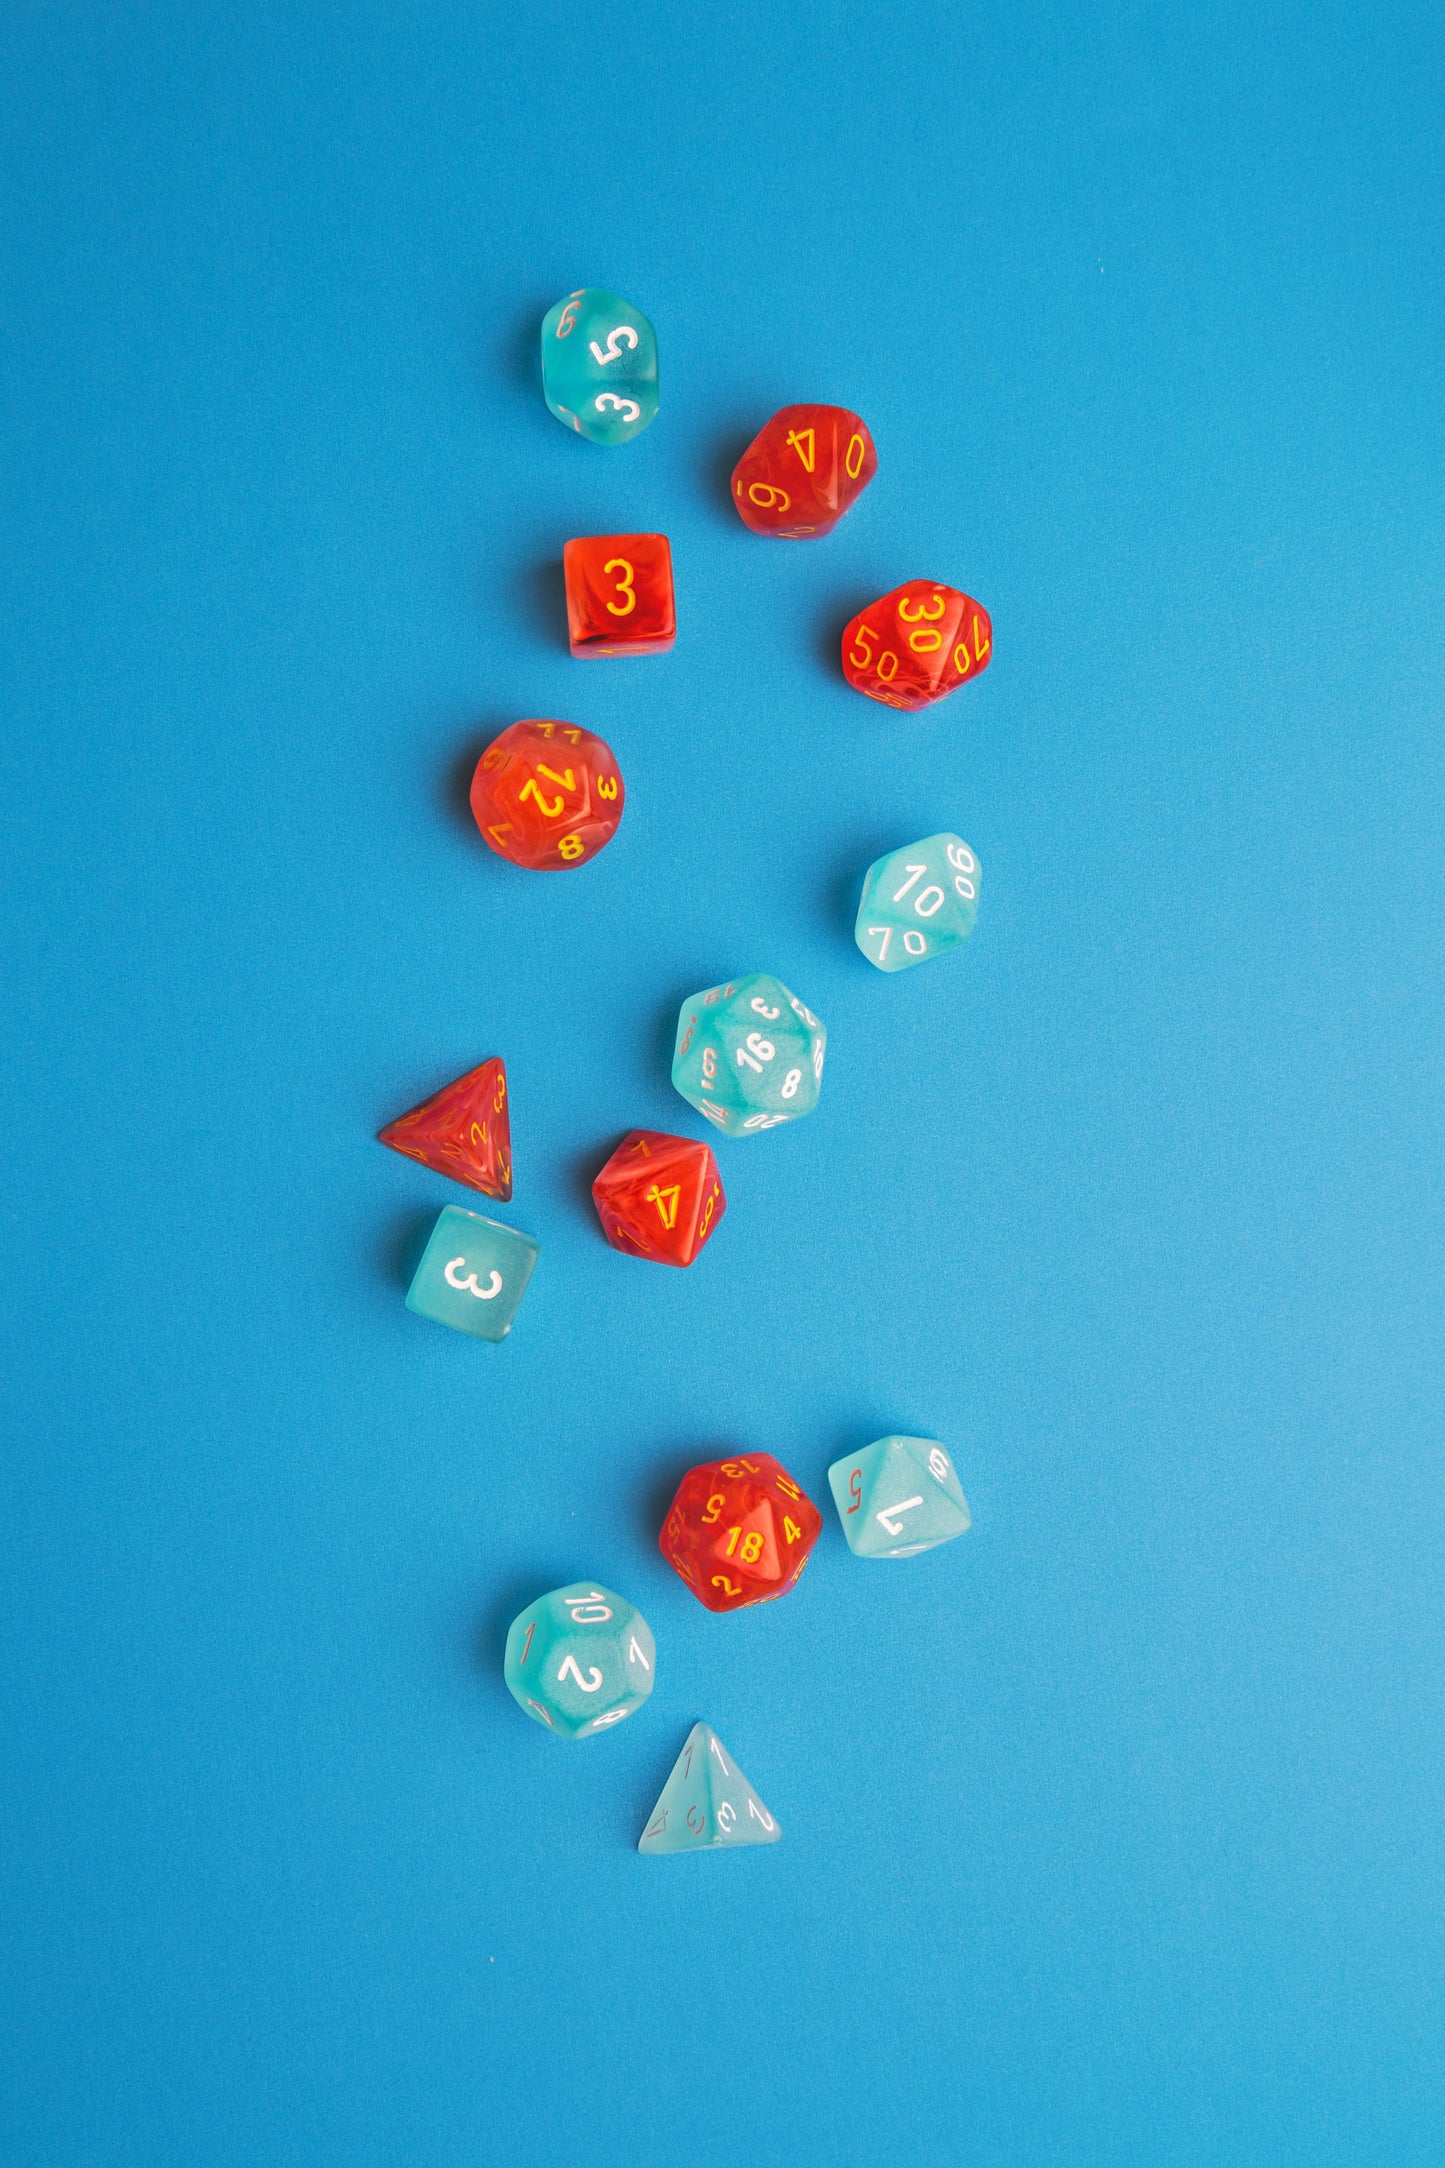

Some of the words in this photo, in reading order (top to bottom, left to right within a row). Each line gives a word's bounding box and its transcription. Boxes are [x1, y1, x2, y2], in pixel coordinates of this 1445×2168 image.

[589, 326, 639, 366] 5
[594, 392, 640, 422] 3
[786, 428, 815, 473] 4
[845, 433, 865, 479] 0
[604, 558, 636, 616] 3
[898, 594, 946, 653] 30
[850, 624, 899, 682] 50
[519, 763, 577, 818] 12
[597, 774, 617, 801] 3
[558, 834, 585, 861] 8
[947, 843, 976, 900] 90
[893, 864, 945, 918] 10
[867, 927, 928, 961] 70
[751, 997, 781, 1020] 3
[736, 1032, 776, 1074] 16
[493, 1074, 506, 1114] 3
[781, 1068, 801, 1099] 8
[470, 1120, 488, 1146] 2
[743, 1113, 789, 1129] 20
[646, 1185, 681, 1230] 4
[444, 1256, 503, 1299] 3
[720, 1459, 761, 1478] 13
[701, 1494, 726, 1524] 5
[847, 1468, 862, 1514] 5
[726, 1526, 765, 1564] 18
[783, 1515, 801, 1545] 4
[711, 1575, 743, 1596] 2
[564, 1591, 613, 1625] 10
[520, 1622, 536, 1665] 1
[557, 1655, 603, 1693] 2
[684, 1744, 695, 1780] 1
[711, 1737, 729, 1776] 1
[686, 1804, 705, 1837] 3
[717, 1801, 737, 1833] 3
[748, 1798, 775, 1833] 2
